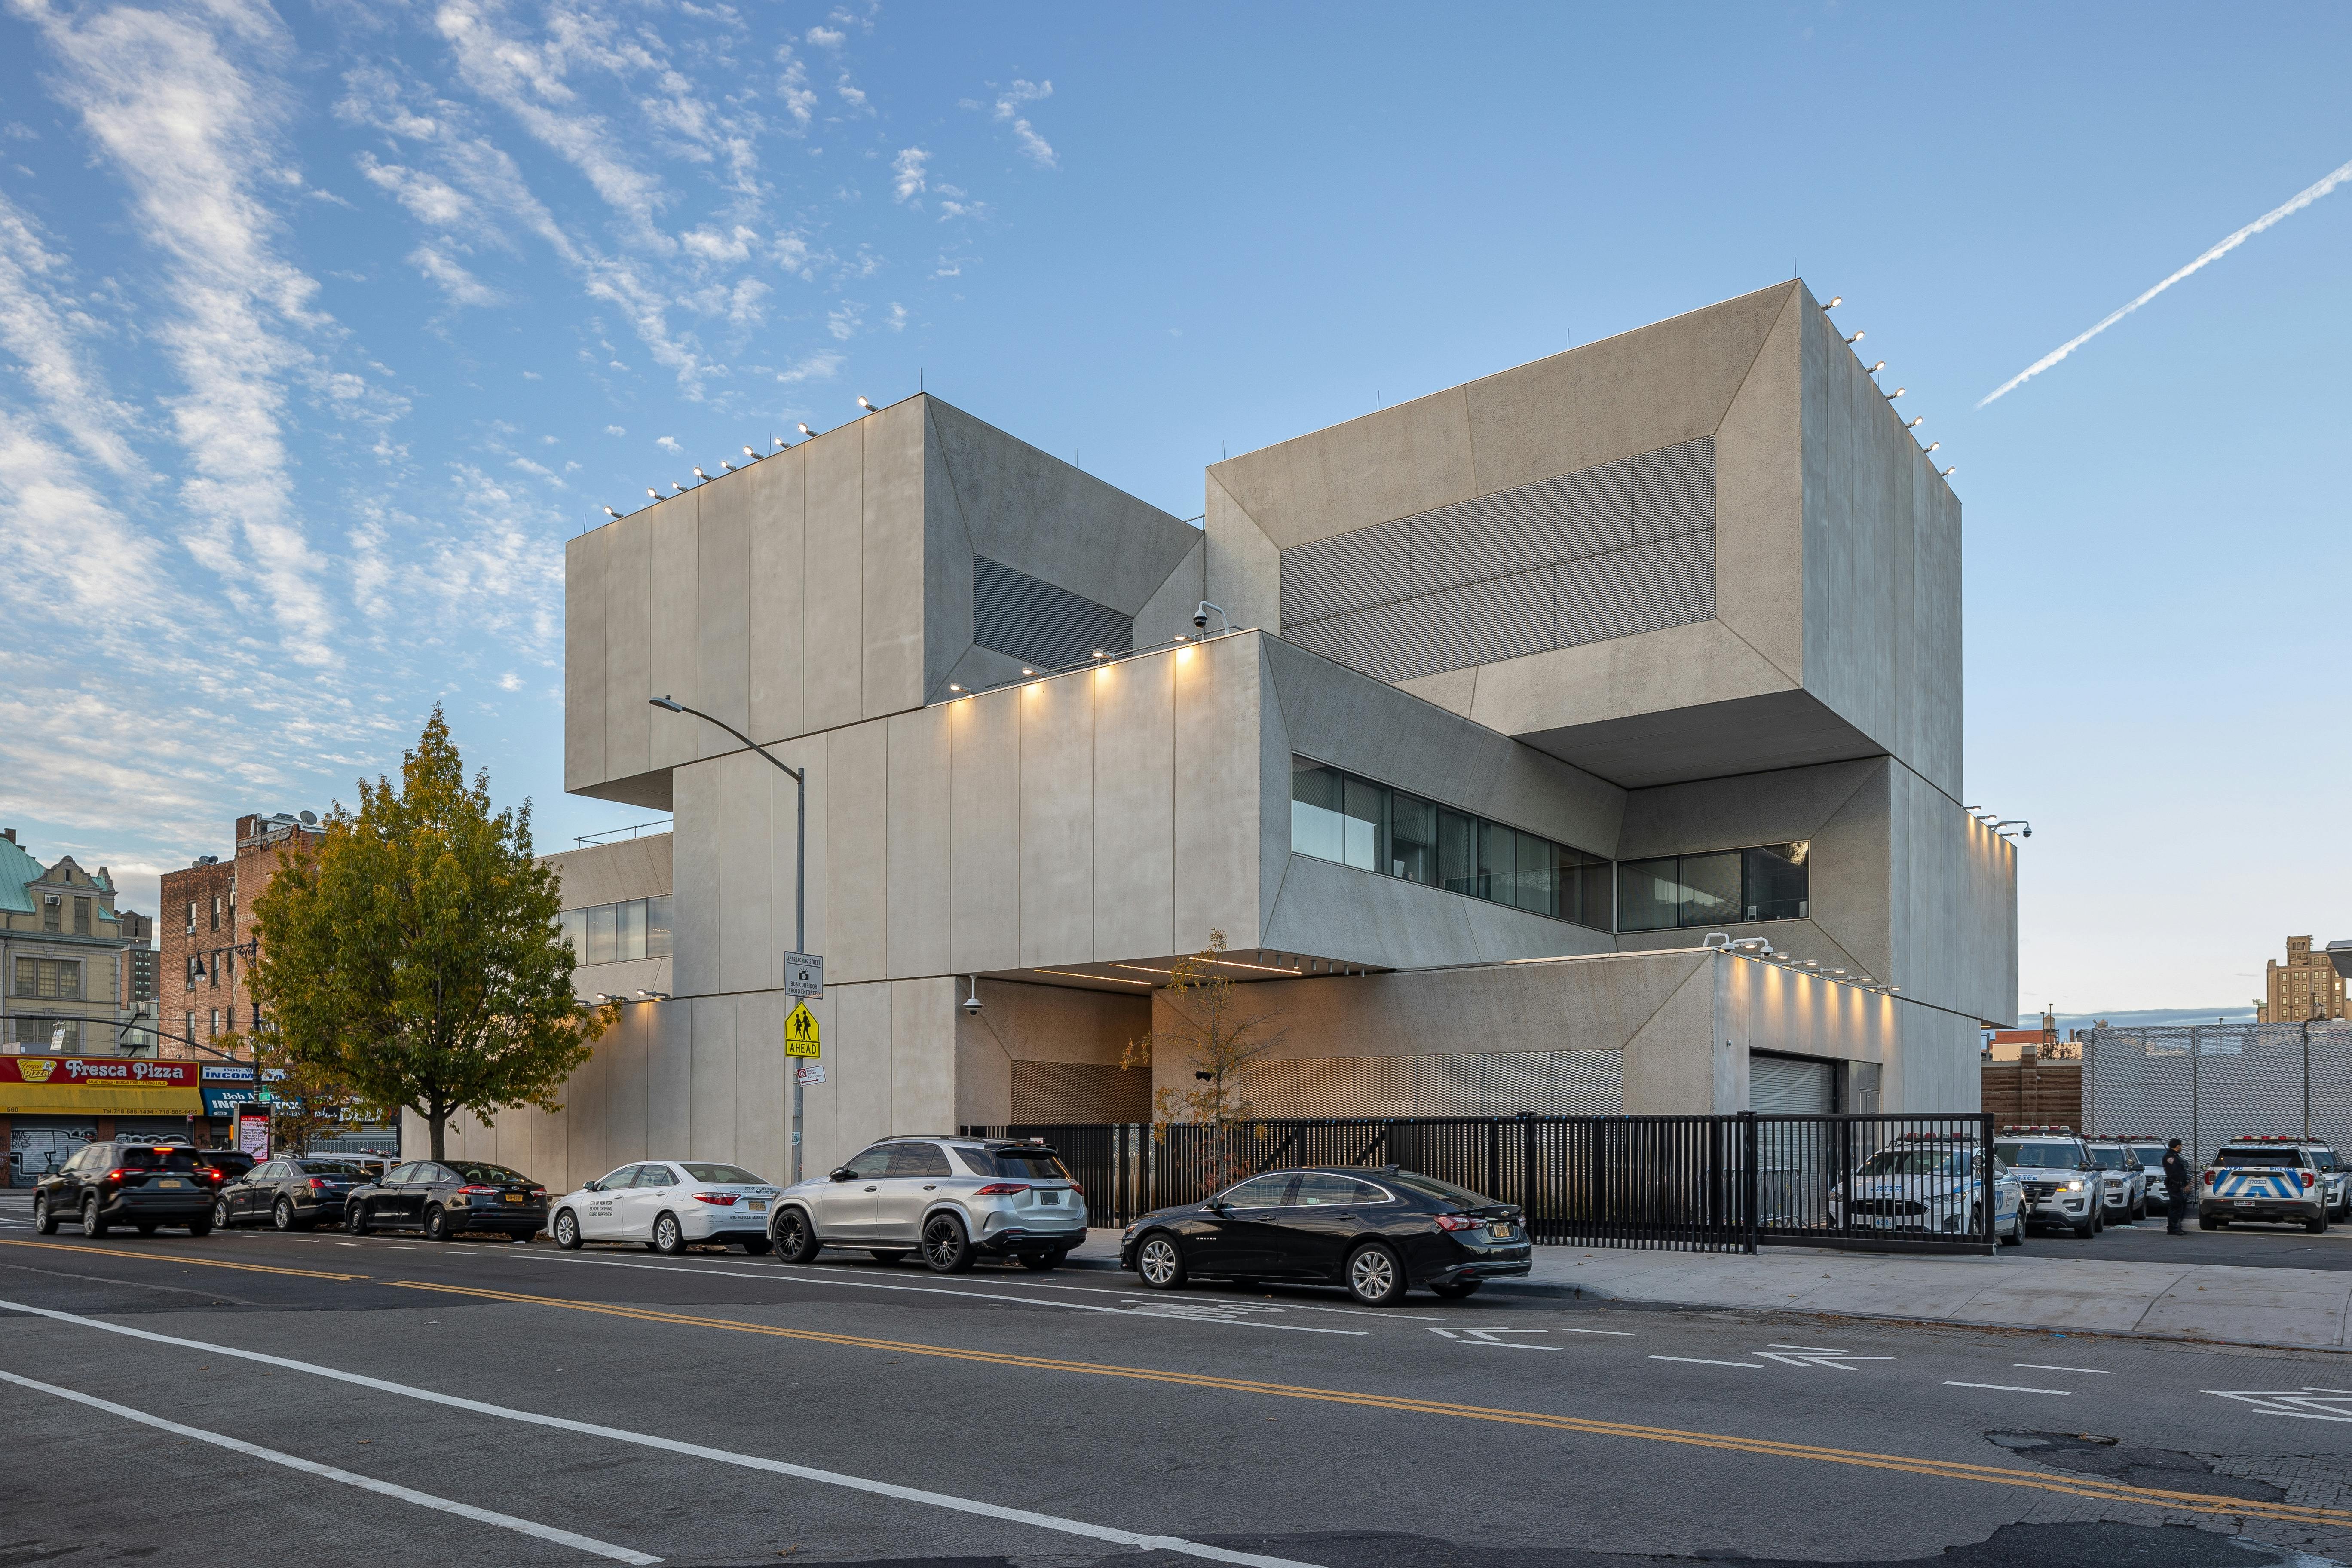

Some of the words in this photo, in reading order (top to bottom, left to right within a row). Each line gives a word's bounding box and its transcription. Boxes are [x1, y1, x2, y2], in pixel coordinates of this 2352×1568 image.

[790, 1043, 816, 1054] AHEAD
[23, 1069, 49, 1078] Pizza
[65, 1060, 127, 1078] Fresca
[133, 1063, 183, 1080] Pizza
